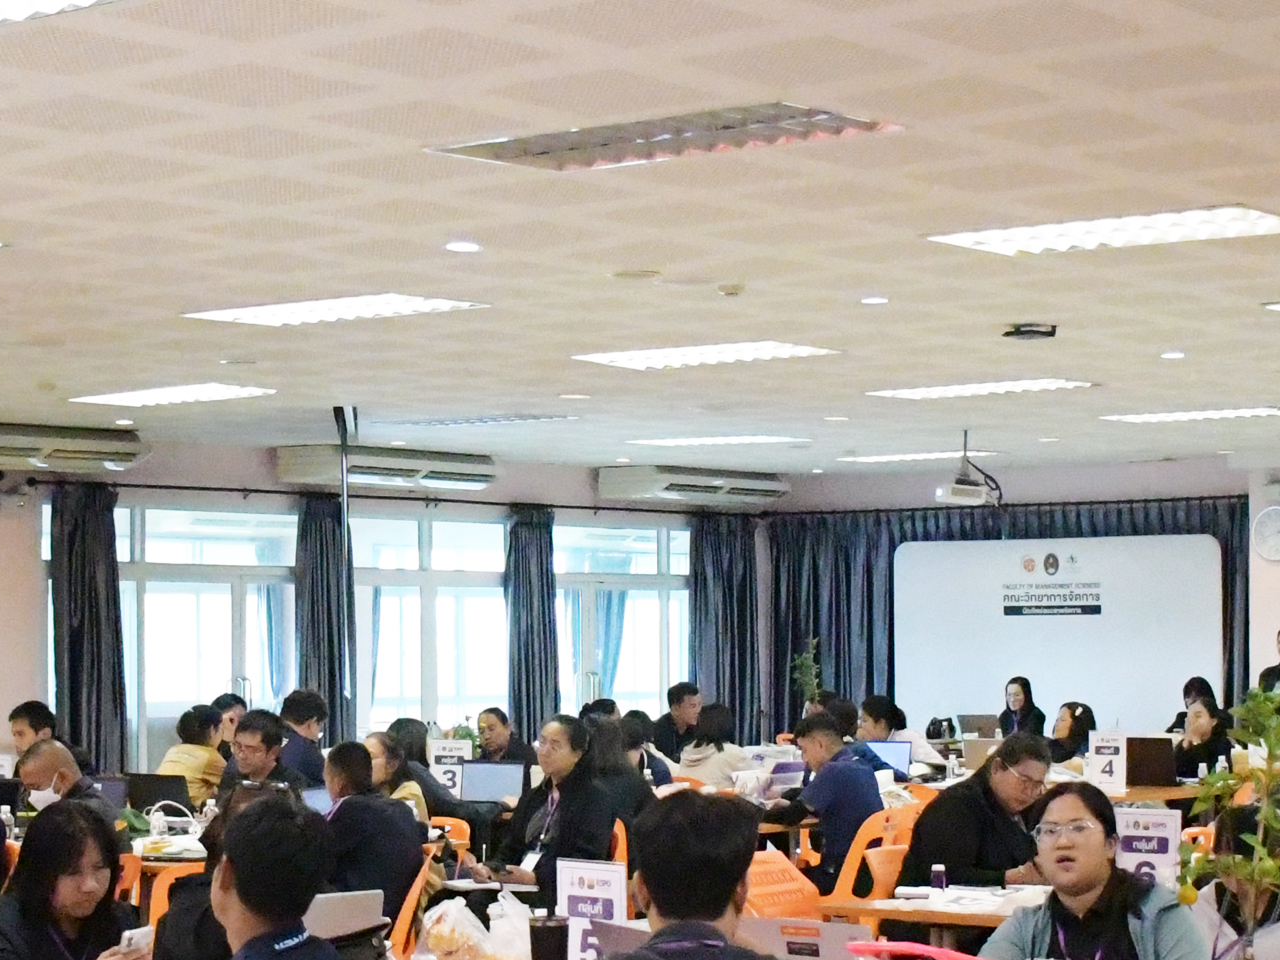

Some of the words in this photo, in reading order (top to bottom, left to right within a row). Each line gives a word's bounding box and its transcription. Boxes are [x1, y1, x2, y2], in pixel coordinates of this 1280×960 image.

[1002, 590, 1101, 603] คณะวิทยาการจัดการ
[1100, 759, 1115, 777] 4
[442, 769, 457, 789] 3
[1134, 860, 1157, 886] 6
[578, 899, 604, 917] กลุ่มที่
